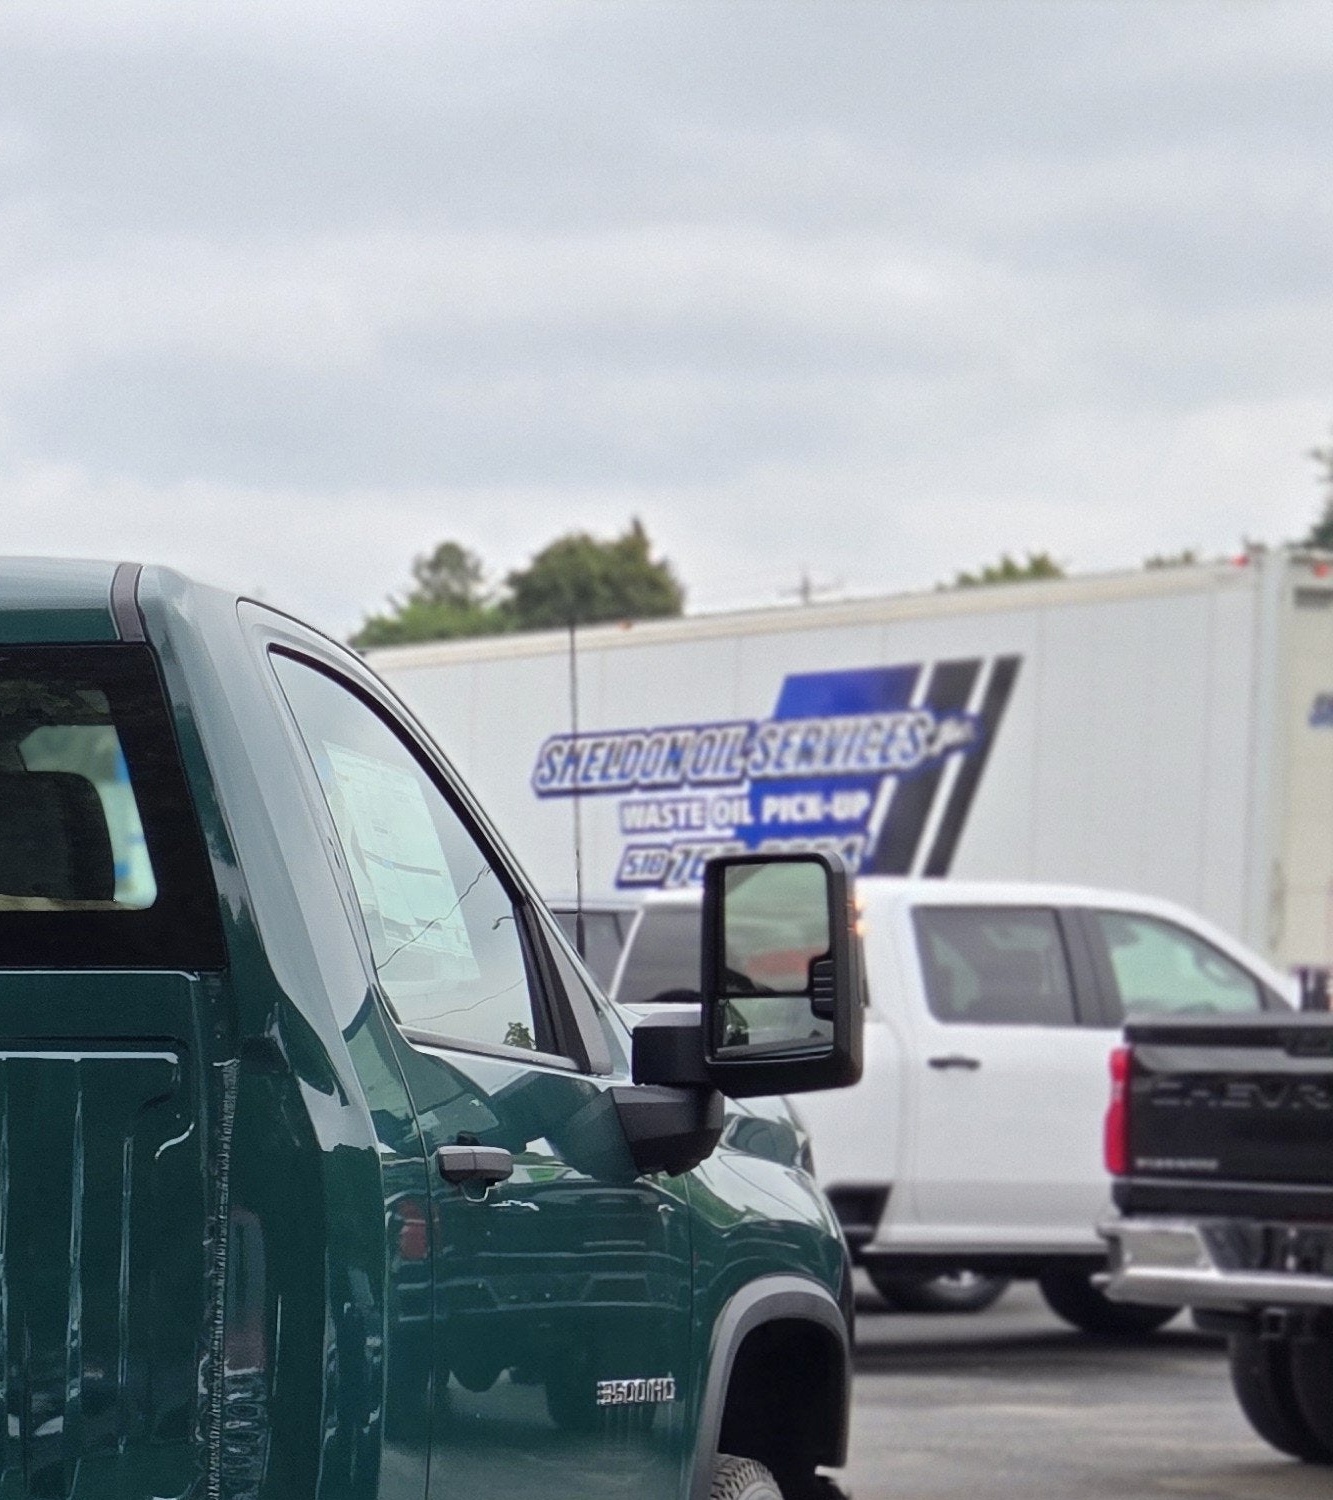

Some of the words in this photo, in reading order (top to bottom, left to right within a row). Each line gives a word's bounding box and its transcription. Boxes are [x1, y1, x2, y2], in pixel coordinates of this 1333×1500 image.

[534, 731, 687, 788] SHELDON
[688, 727, 746, 779] OIL
[747, 713, 931, 776] SERVICES
[621, 801, 705, 832] WASTE
[712, 797, 755, 826] OIL
[761, 790, 871, 824] PICK-UP
